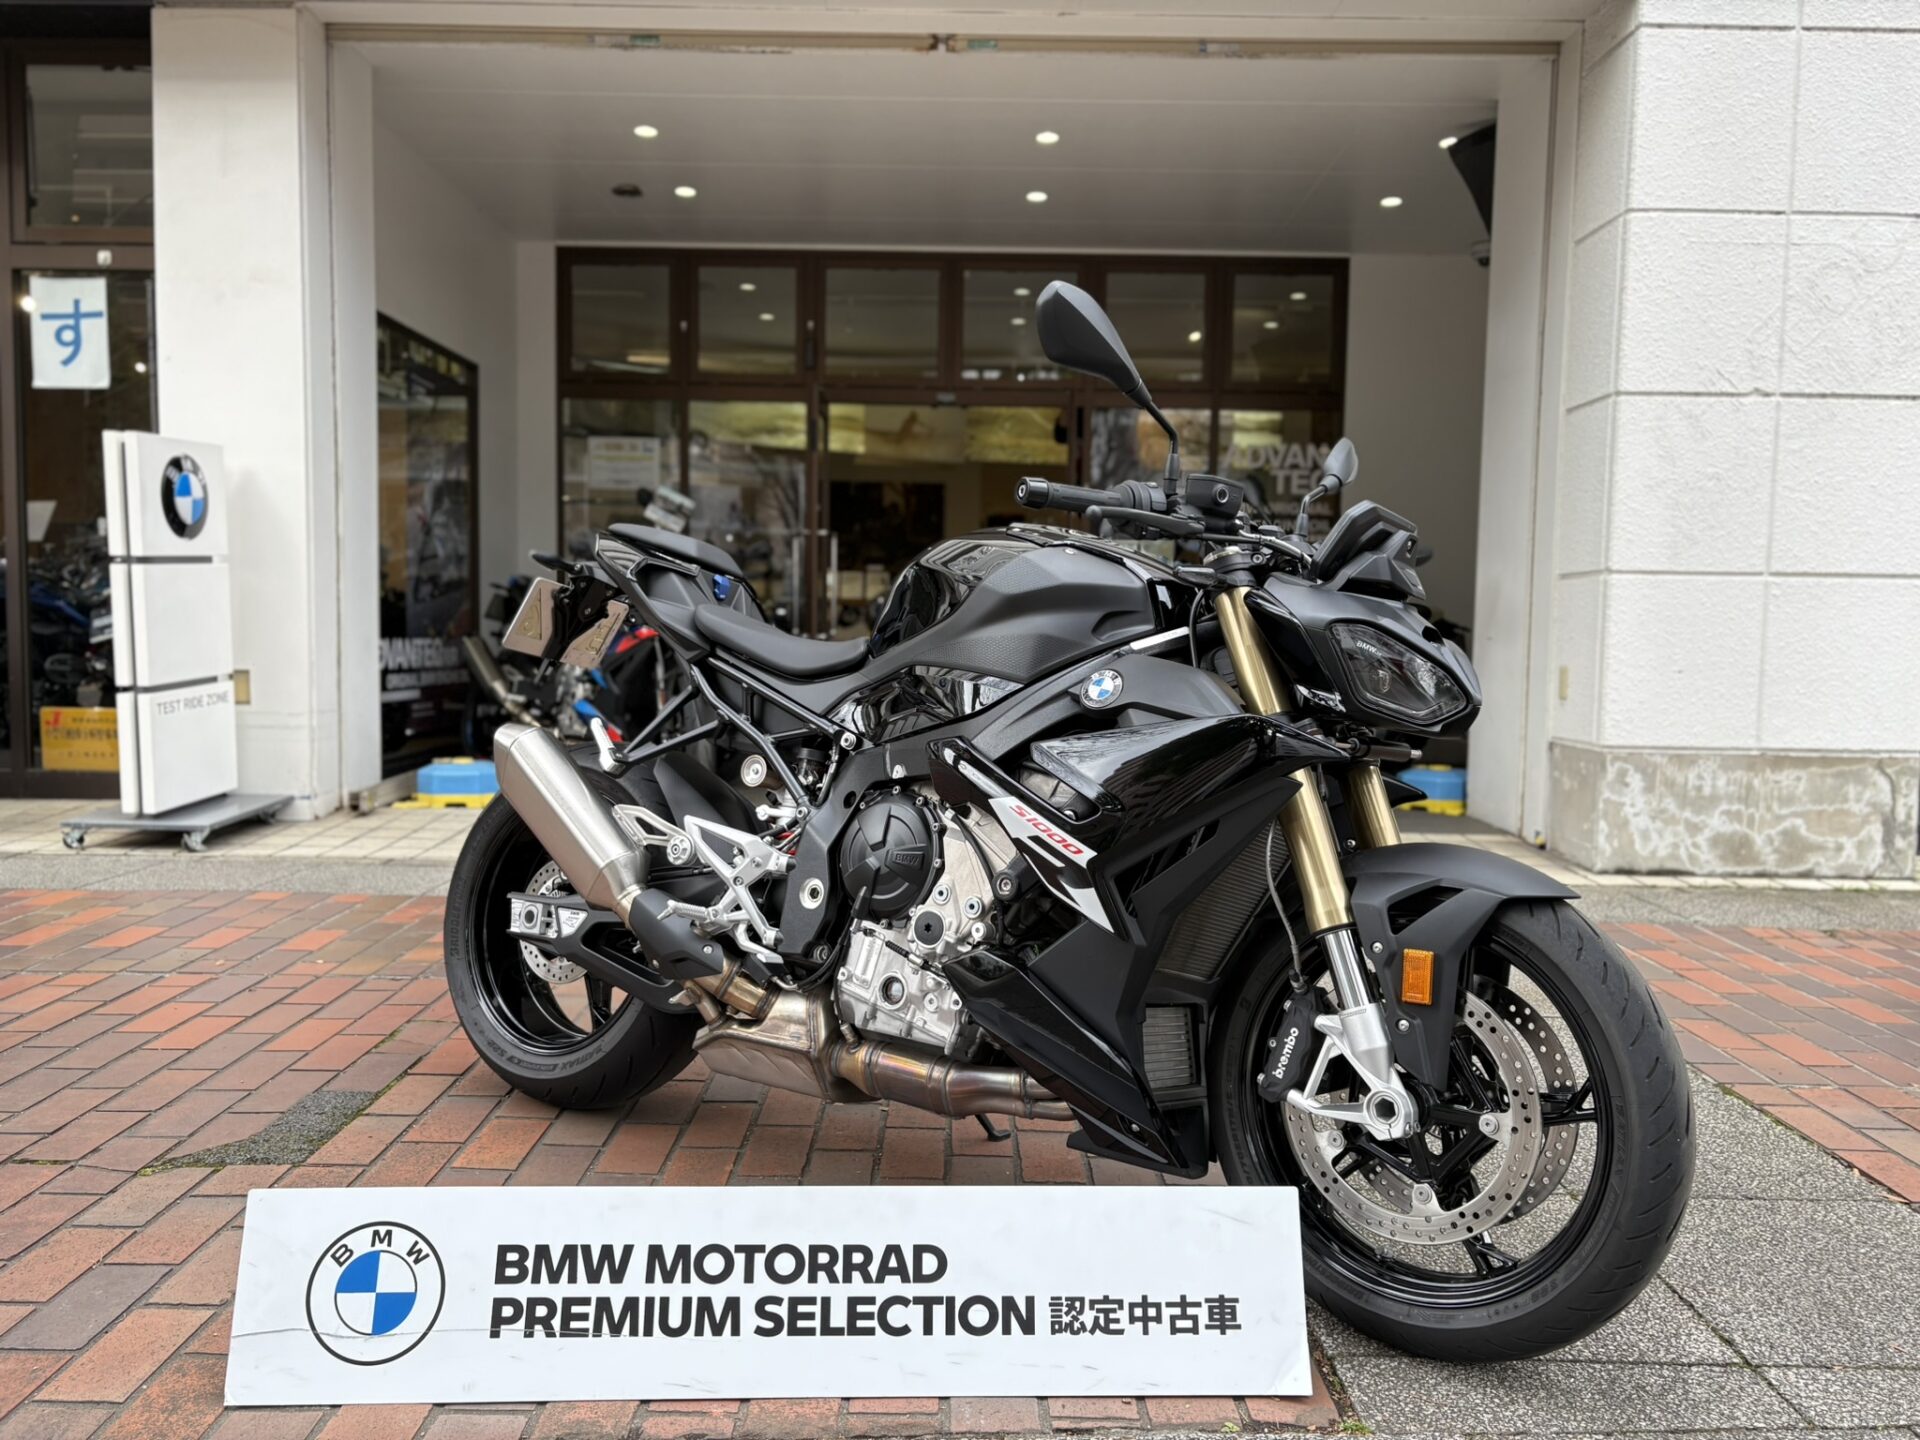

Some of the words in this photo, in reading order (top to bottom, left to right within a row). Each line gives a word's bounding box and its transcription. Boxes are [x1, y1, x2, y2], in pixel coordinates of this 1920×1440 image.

[41, 299, 103, 367] す
[157, 699, 180, 716] TEST
[184, 694, 204, 710] RIDE
[1272, 1027, 1299, 1079] brembo
[331, 1230, 430, 1268] BMW
[495, 1245, 635, 1285] BMW
[646, 1244, 948, 1285] MOTORRAD
[490, 1296, 741, 1338] PREMIUM
[754, 1295, 1036, 1338] SELECTION
[1049, 1294, 1242, 1336] 認定中古車
